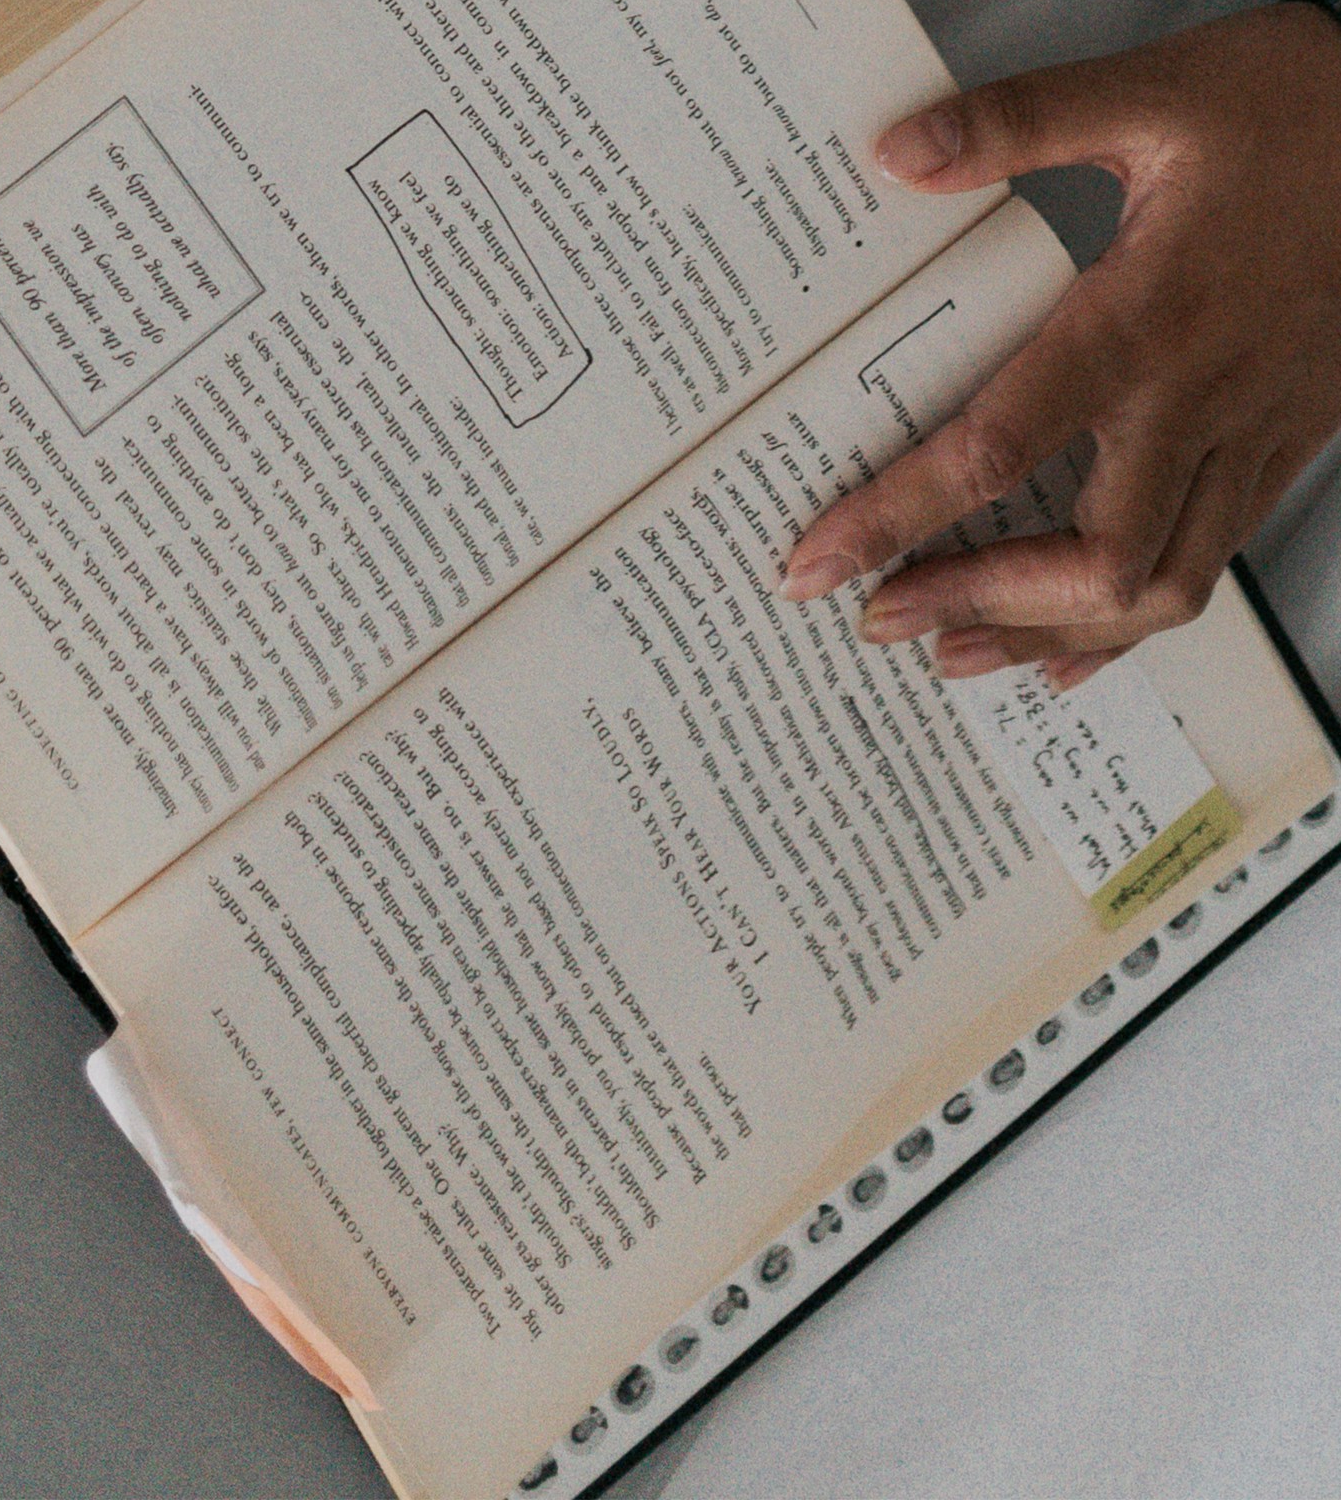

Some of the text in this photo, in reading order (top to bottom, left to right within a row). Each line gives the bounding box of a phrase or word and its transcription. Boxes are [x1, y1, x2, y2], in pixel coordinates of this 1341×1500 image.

[105, 142, 222, 300] what we actually say.
[85, 183, 193, 323] nothing to do with
[22, 220, 137, 369] of the impression we
[22, 287, 45, 312] 90
[71, 223, 166, 345] often convey has
[44, 311, 77, 351] than
[71, 351, 107, 394] More
[4, 688, 80, 791] CONNECTING
[1032, 743, 1054, 789] say
[1063, 746, 1083, 780] say
[1076, 719, 1159, 841] What they see
[1060, 801, 1079, 824] we
[1089, 788, 1111, 814] we
[1079, 833, 1112, 880] What
[1115, 822, 1139, 860] How
[211, 1007, 417, 1327] EVERYONE COMMUNICATES, FEW CONNECT
